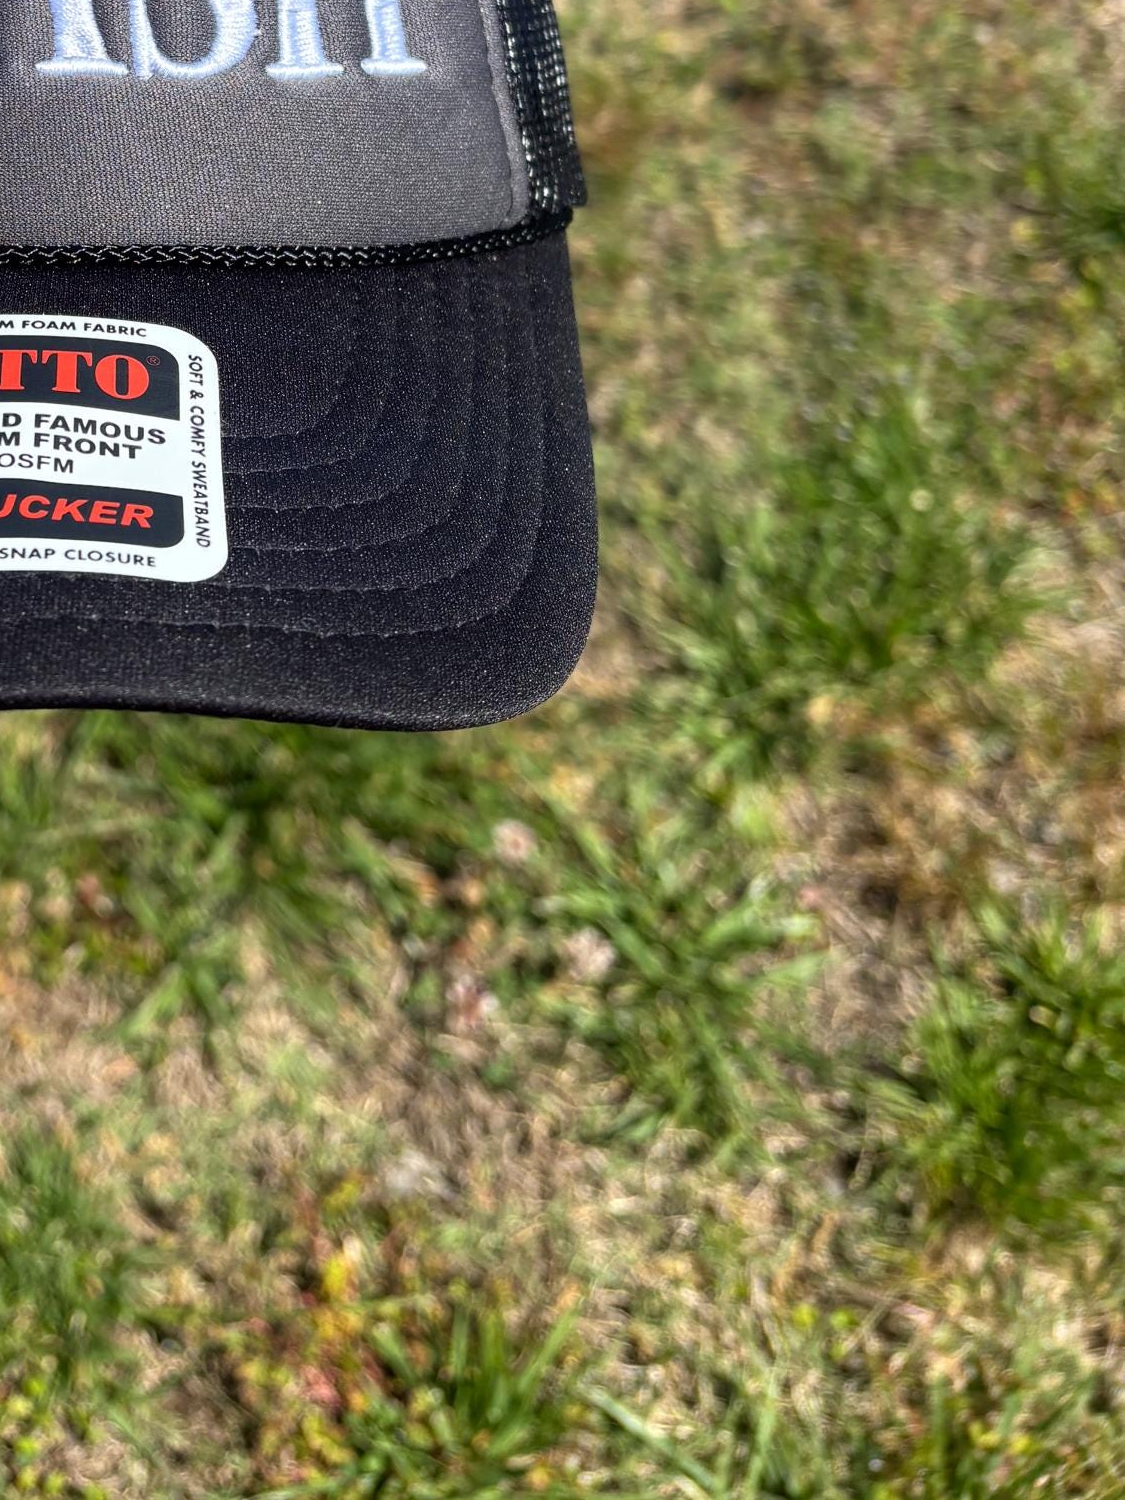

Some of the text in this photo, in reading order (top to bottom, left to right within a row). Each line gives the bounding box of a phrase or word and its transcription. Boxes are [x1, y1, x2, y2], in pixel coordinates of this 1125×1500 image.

[22, 320, 76, 331] FOAM
[84, 322, 147, 337] FABRIC
[34, 414, 166, 445] FAMOUS
[34, 434, 142, 459] FRONT
[188, 355, 211, 548] SOFT & COMFY SWEATBAND
[0, 548, 56, 560] SNAP
[64, 549, 156, 568] CLOSURE
